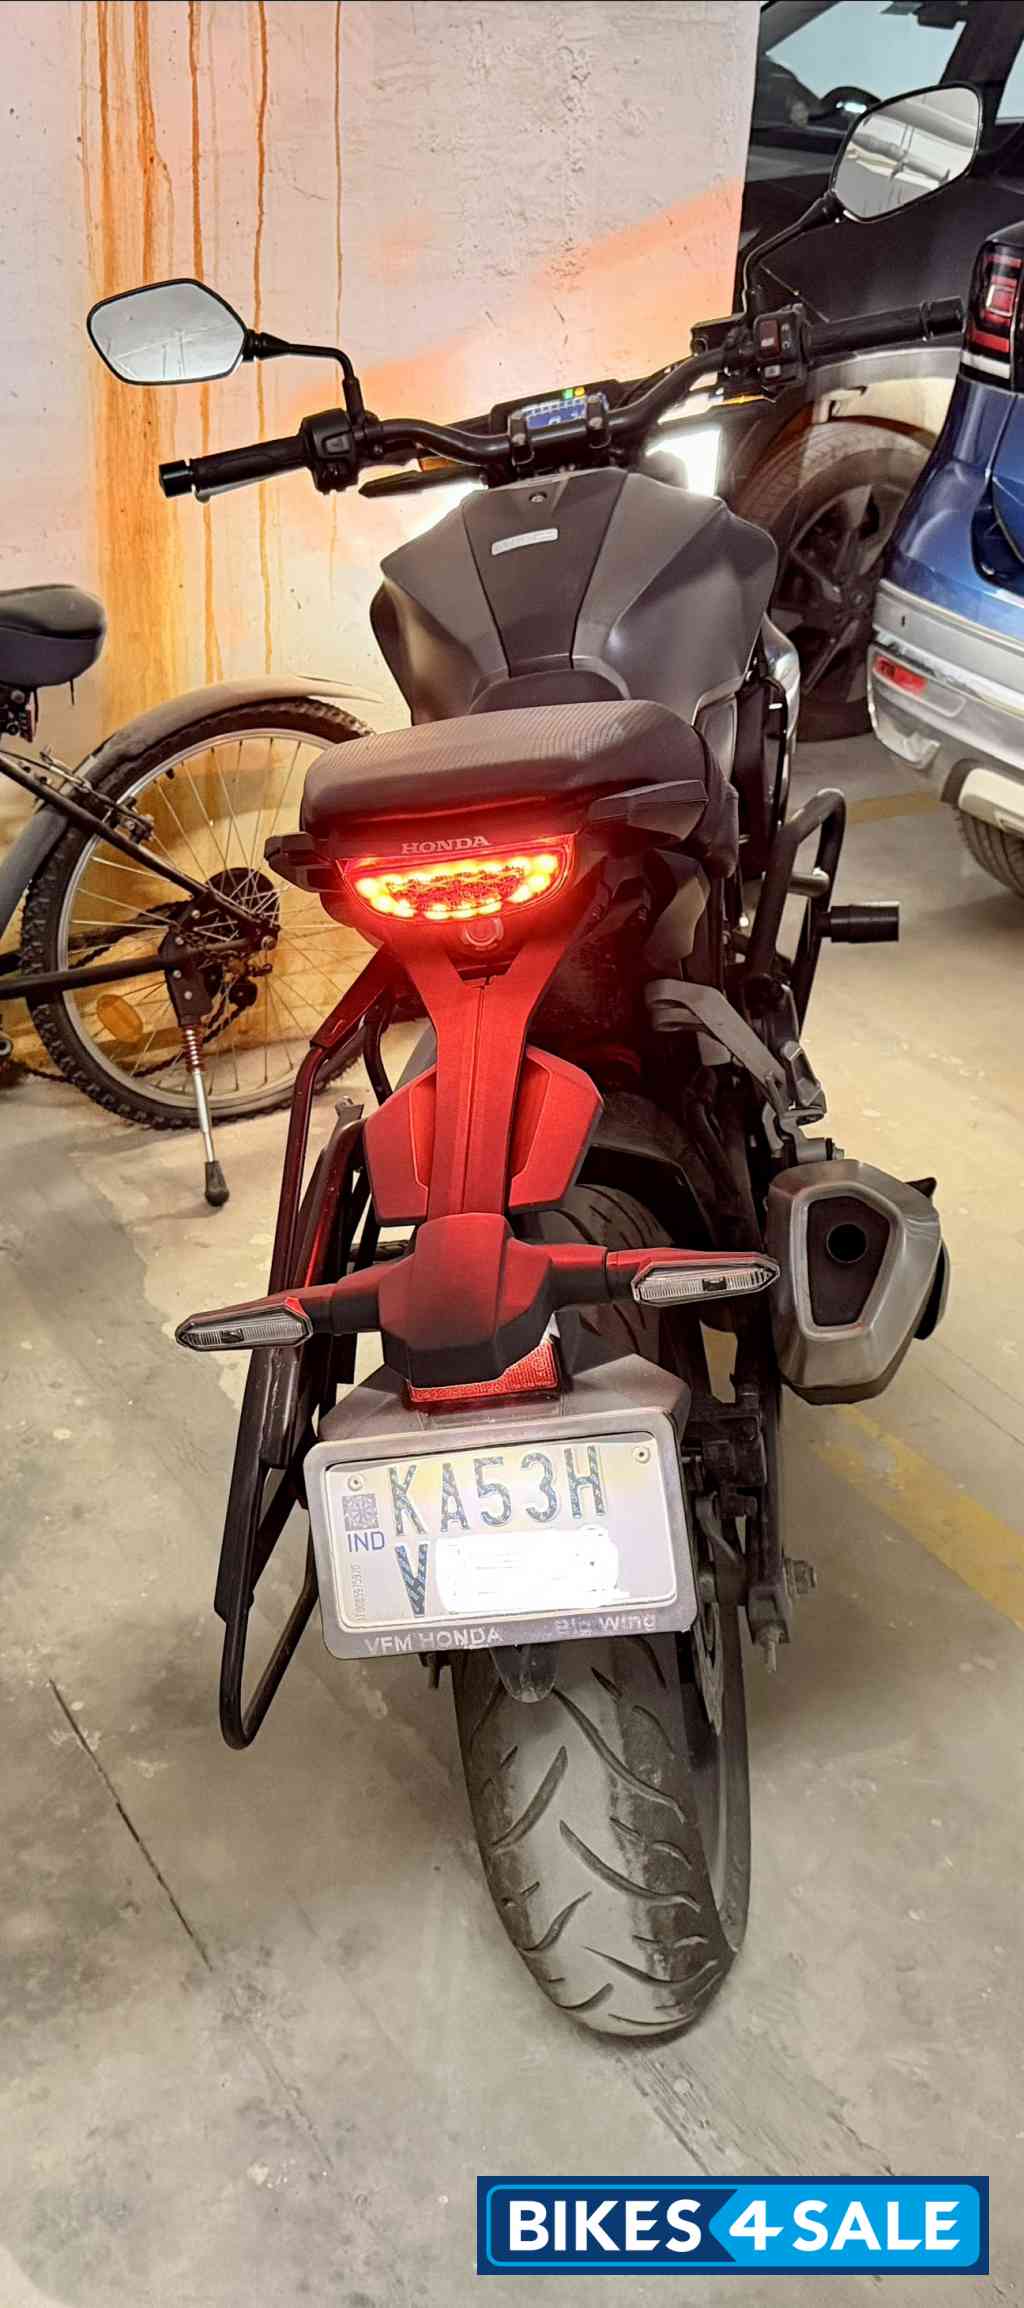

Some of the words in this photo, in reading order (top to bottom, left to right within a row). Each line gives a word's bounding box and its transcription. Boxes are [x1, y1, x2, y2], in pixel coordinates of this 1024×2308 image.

[401, 835, 491, 854] HONDA
[388, 1445, 606, 1536] KA53H
[348, 1531, 385, 1552] IND
[363, 1634, 412, 1654] VFM
[418, 1627, 504, 1650] HONDA
[597, 1613, 657, 1632] Wing
